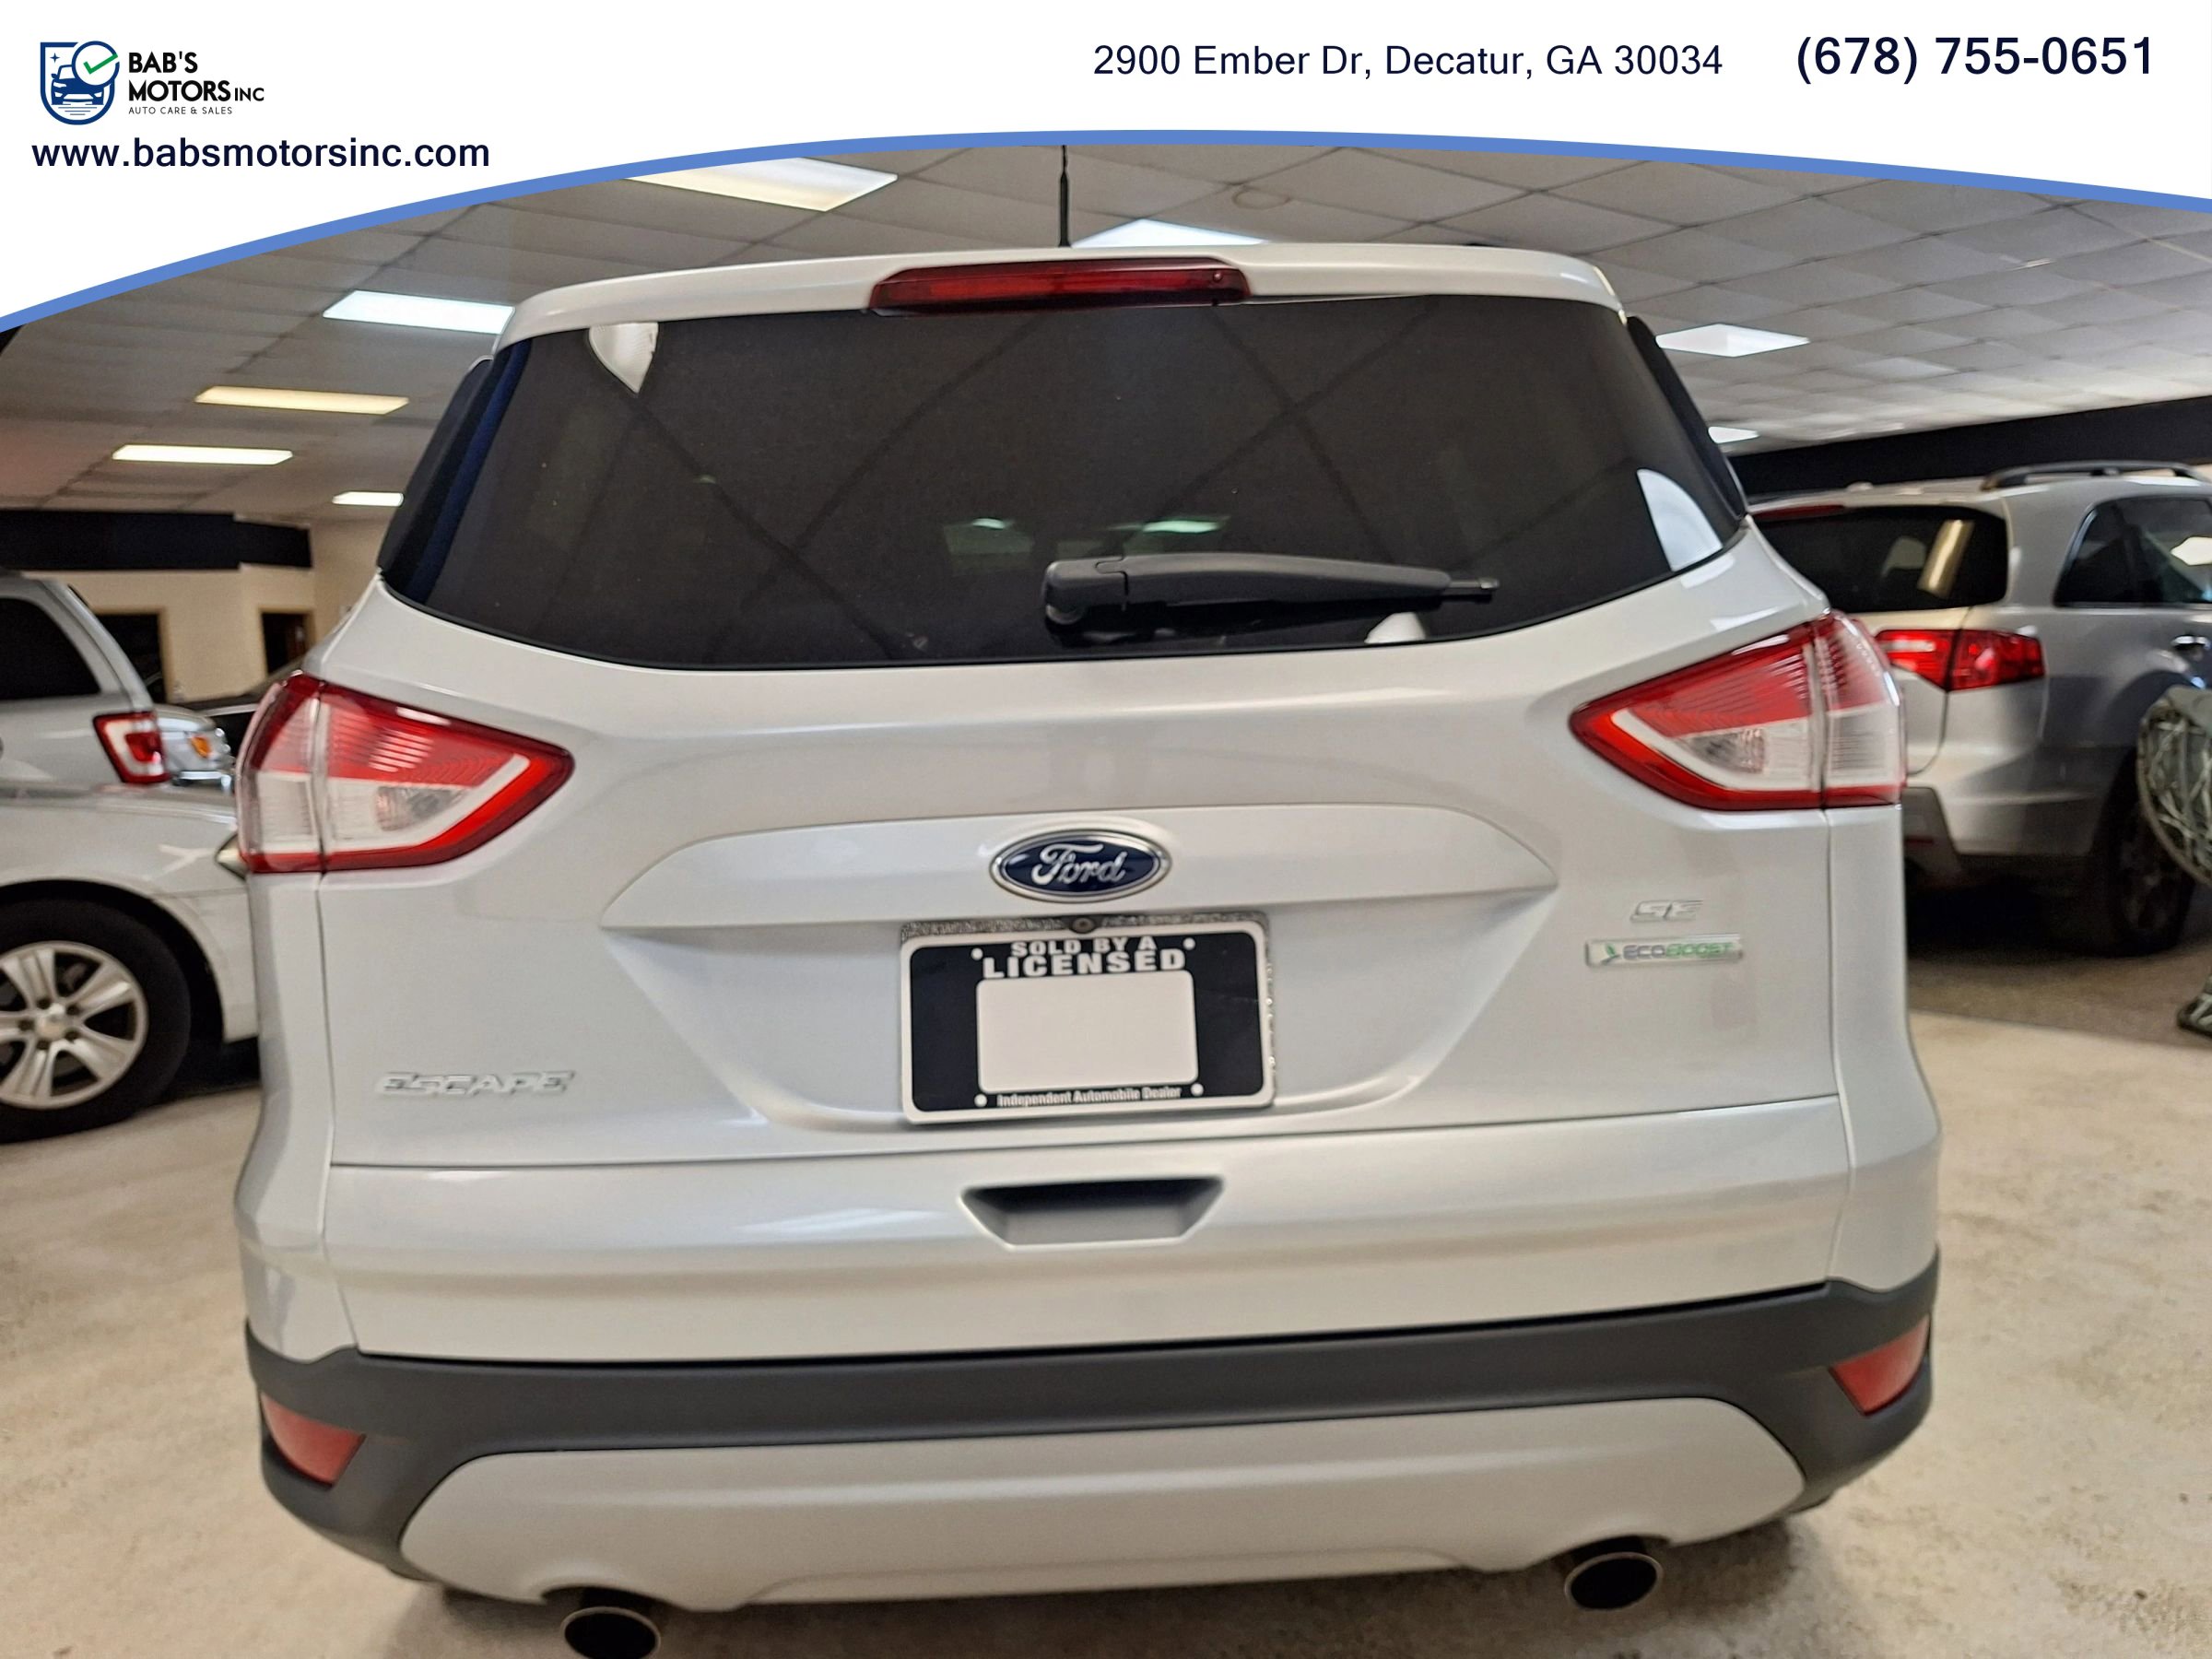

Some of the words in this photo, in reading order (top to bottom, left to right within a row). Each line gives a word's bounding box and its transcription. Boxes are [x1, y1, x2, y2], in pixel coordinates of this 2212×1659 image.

[1031, 843, 1128, 885] Ford
[1011, 939, 1082, 959] SOLD
[1093, 936, 1129, 954] BY
[1138, 935, 1157, 950] A
[982, 948, 1186, 979] LICENSED
[374, 1070, 577, 1097] ESCAPE
[997, 1090, 1072, 1108] Independent
[1073, 1088, 1141, 1103] Automobile
[1142, 1086, 1182, 1100] Dealer
